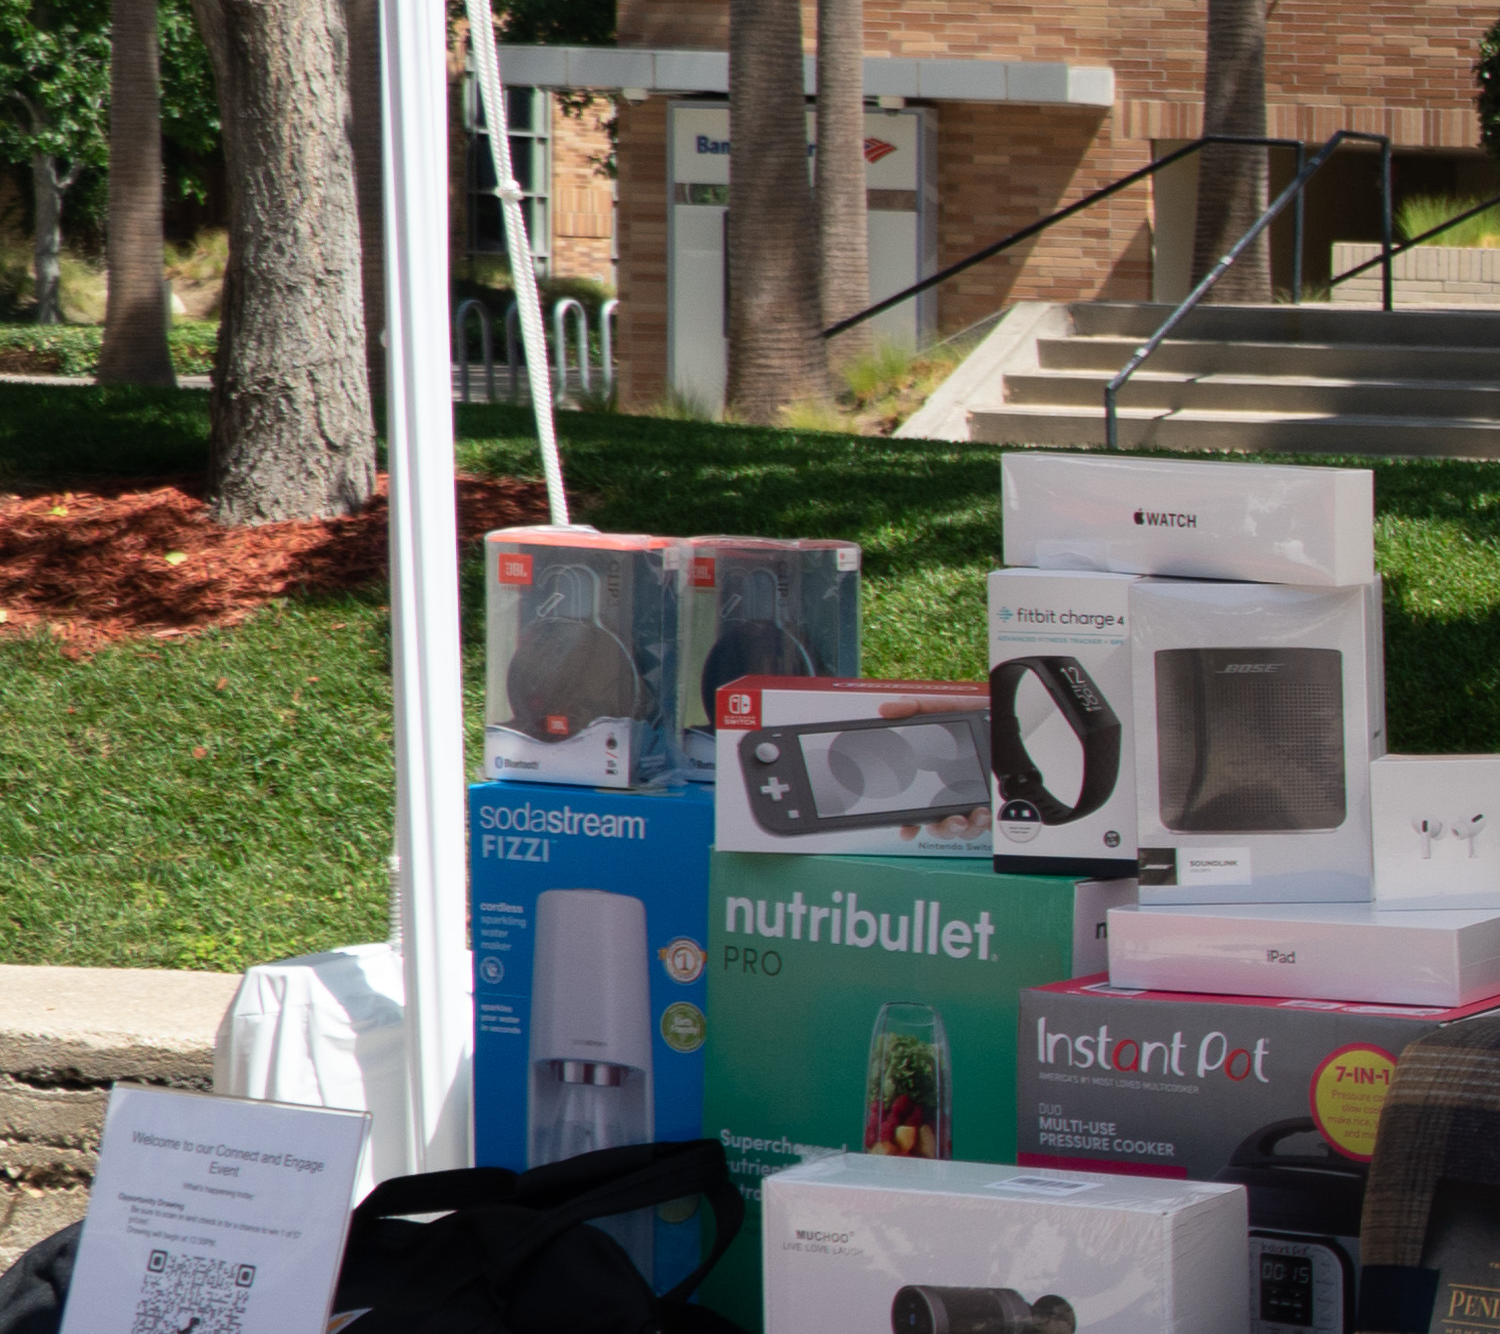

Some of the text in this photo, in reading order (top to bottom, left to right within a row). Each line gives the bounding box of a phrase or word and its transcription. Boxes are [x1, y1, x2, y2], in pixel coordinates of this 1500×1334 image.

[696, 135, 730, 154] Ban
[1145, 511, 1197, 528] WATCH
[505, 561, 527, 577] JBL
[1017, 608, 1125, 629] fitbit charge 4
[1216, 663, 1285, 673] BOSE
[479, 802, 646, 839] sodastream
[482, 834, 550, 862] FIZZI
[918, 840, 993, 851] Nintendo Switc
[480, 927, 509, 938] water
[725, 891, 993, 963] nutribullet
[723, 945, 783, 977] PRO
[1266, 950, 1295, 965] iPad
[1038, 1017, 1269, 1083] Instant Pot
[1335, 1066, 1390, 1085] 7-IN-1
[1038, 1103, 1061, 1116] DUO
[1039, 1117, 1117, 1136] MULTI-USE
[132, 1129, 325, 1176] Welcome to our Connect and Engage
[1039, 1132, 1175, 1157] PRESSURE COOKER
[209, 1160, 240, 1178] Event
